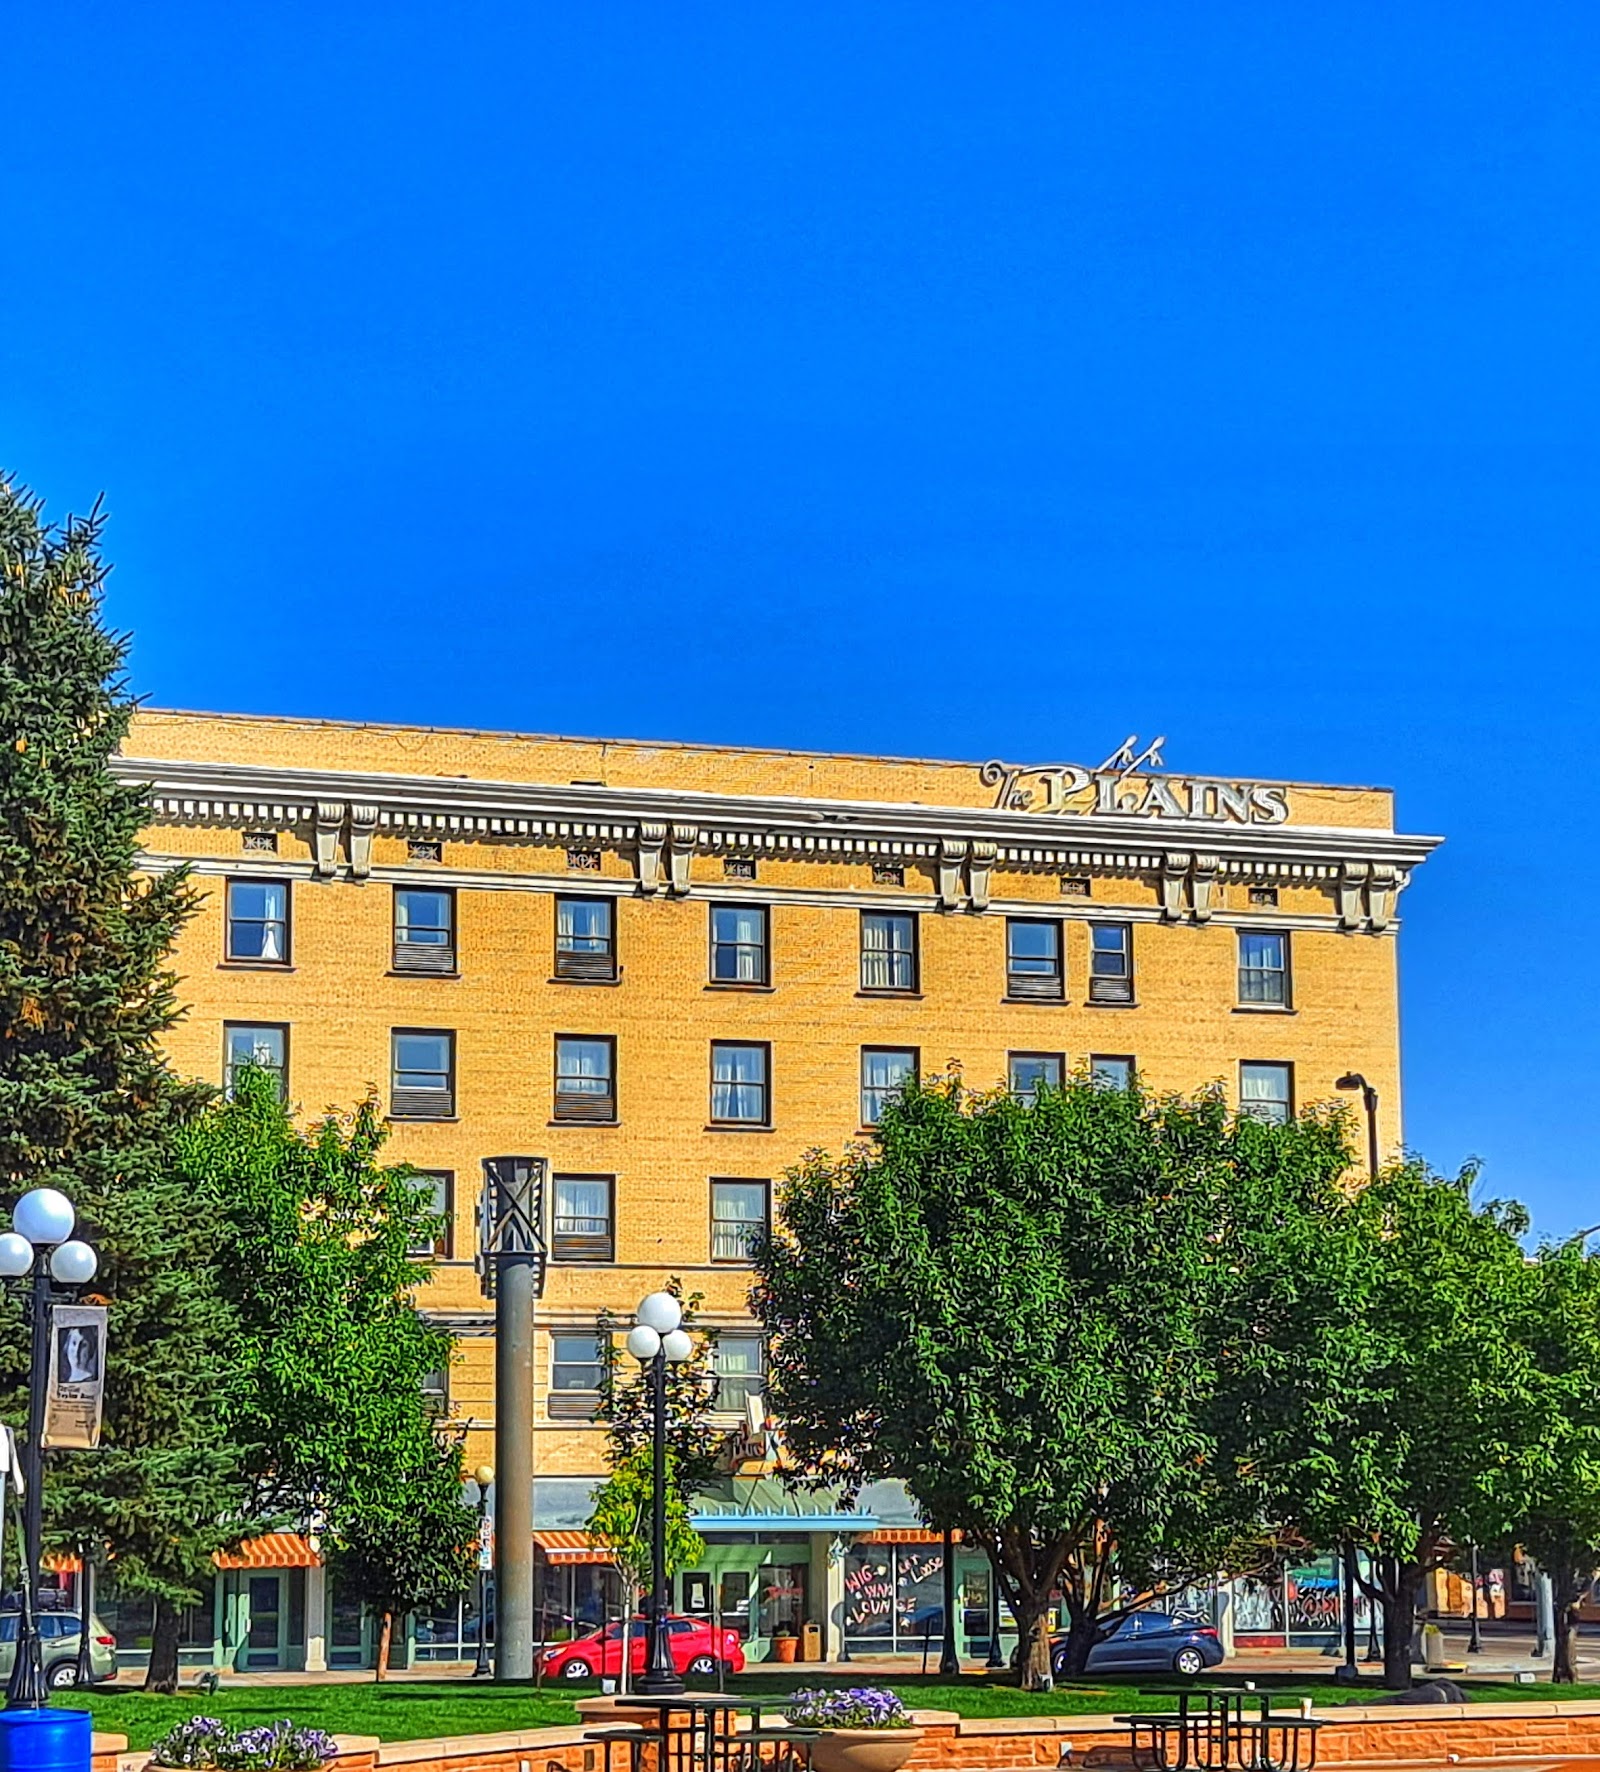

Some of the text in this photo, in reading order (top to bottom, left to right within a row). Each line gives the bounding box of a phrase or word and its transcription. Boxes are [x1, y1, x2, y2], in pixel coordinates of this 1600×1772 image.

[980, 760, 1289, 825] The PLAINS
[845, 1564, 873, 1594] WIG
